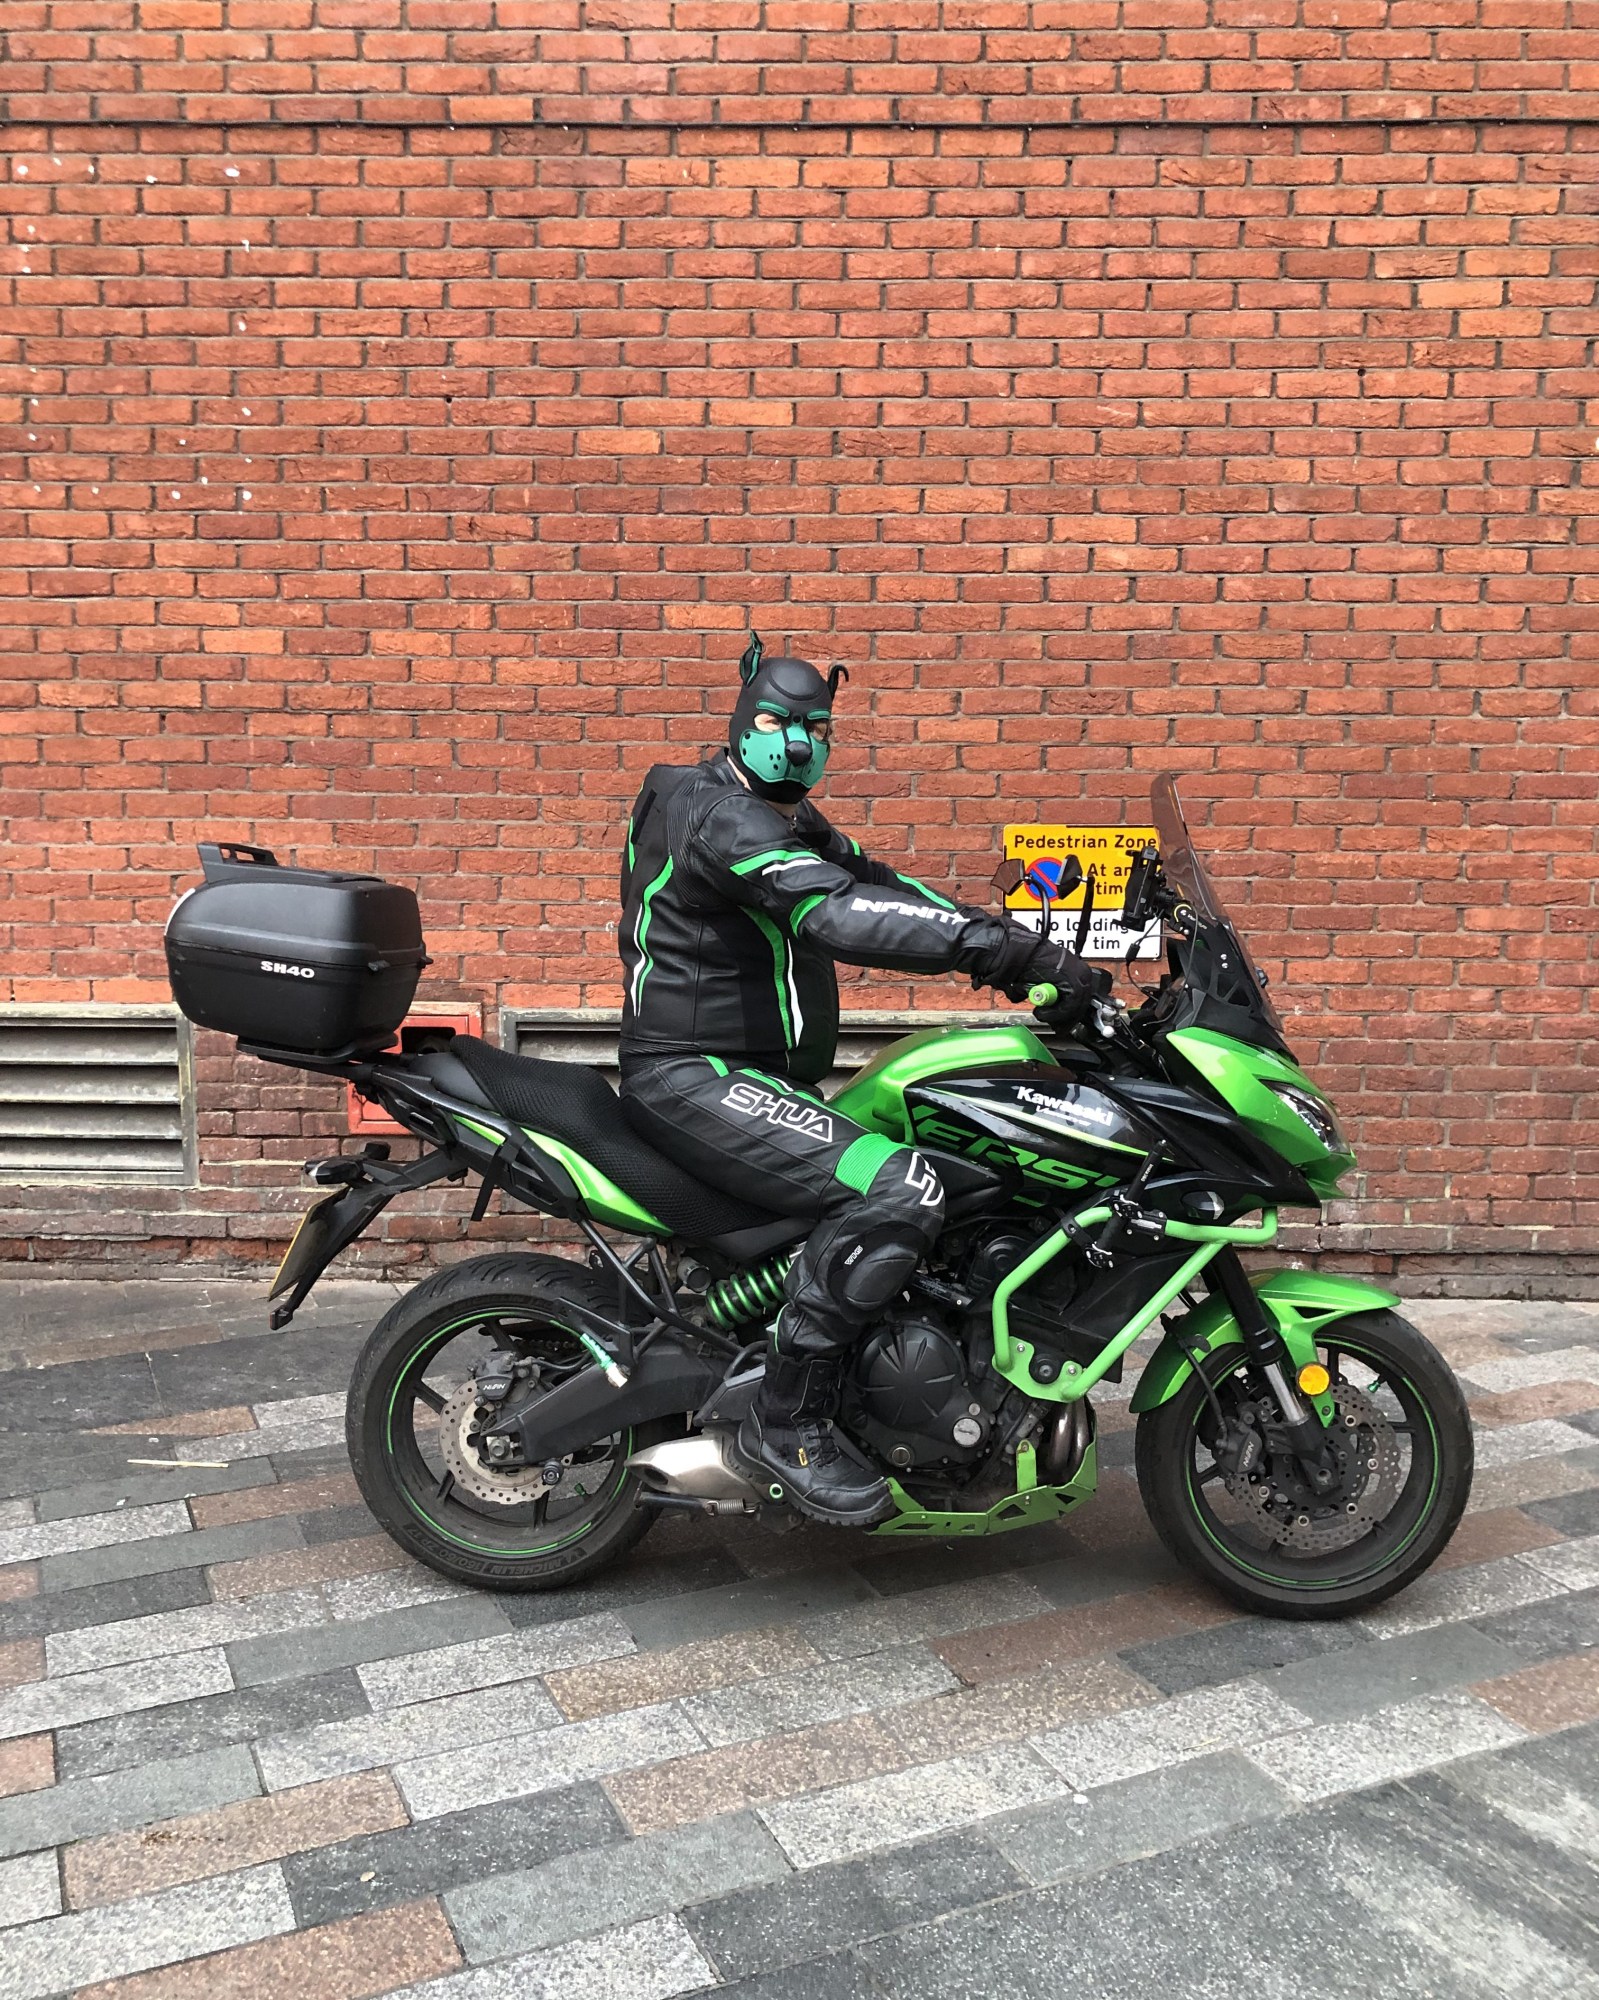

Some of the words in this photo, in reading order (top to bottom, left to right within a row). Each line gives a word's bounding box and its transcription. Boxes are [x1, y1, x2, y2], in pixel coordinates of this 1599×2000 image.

[1014, 834, 1107, 849] Pedestrian
[1114, 834, 1157, 849] Zone
[1087, 863, 1107, 877] At
[1113, 866, 1132, 877] an
[851, 897, 971, 925] INFINITY
[1066, 918, 1129, 934] loding
[260, 960, 315, 979] SH40
[720, 1082, 833, 1143] SHUA
[1016, 1085, 1114, 1127] Kawasaki
